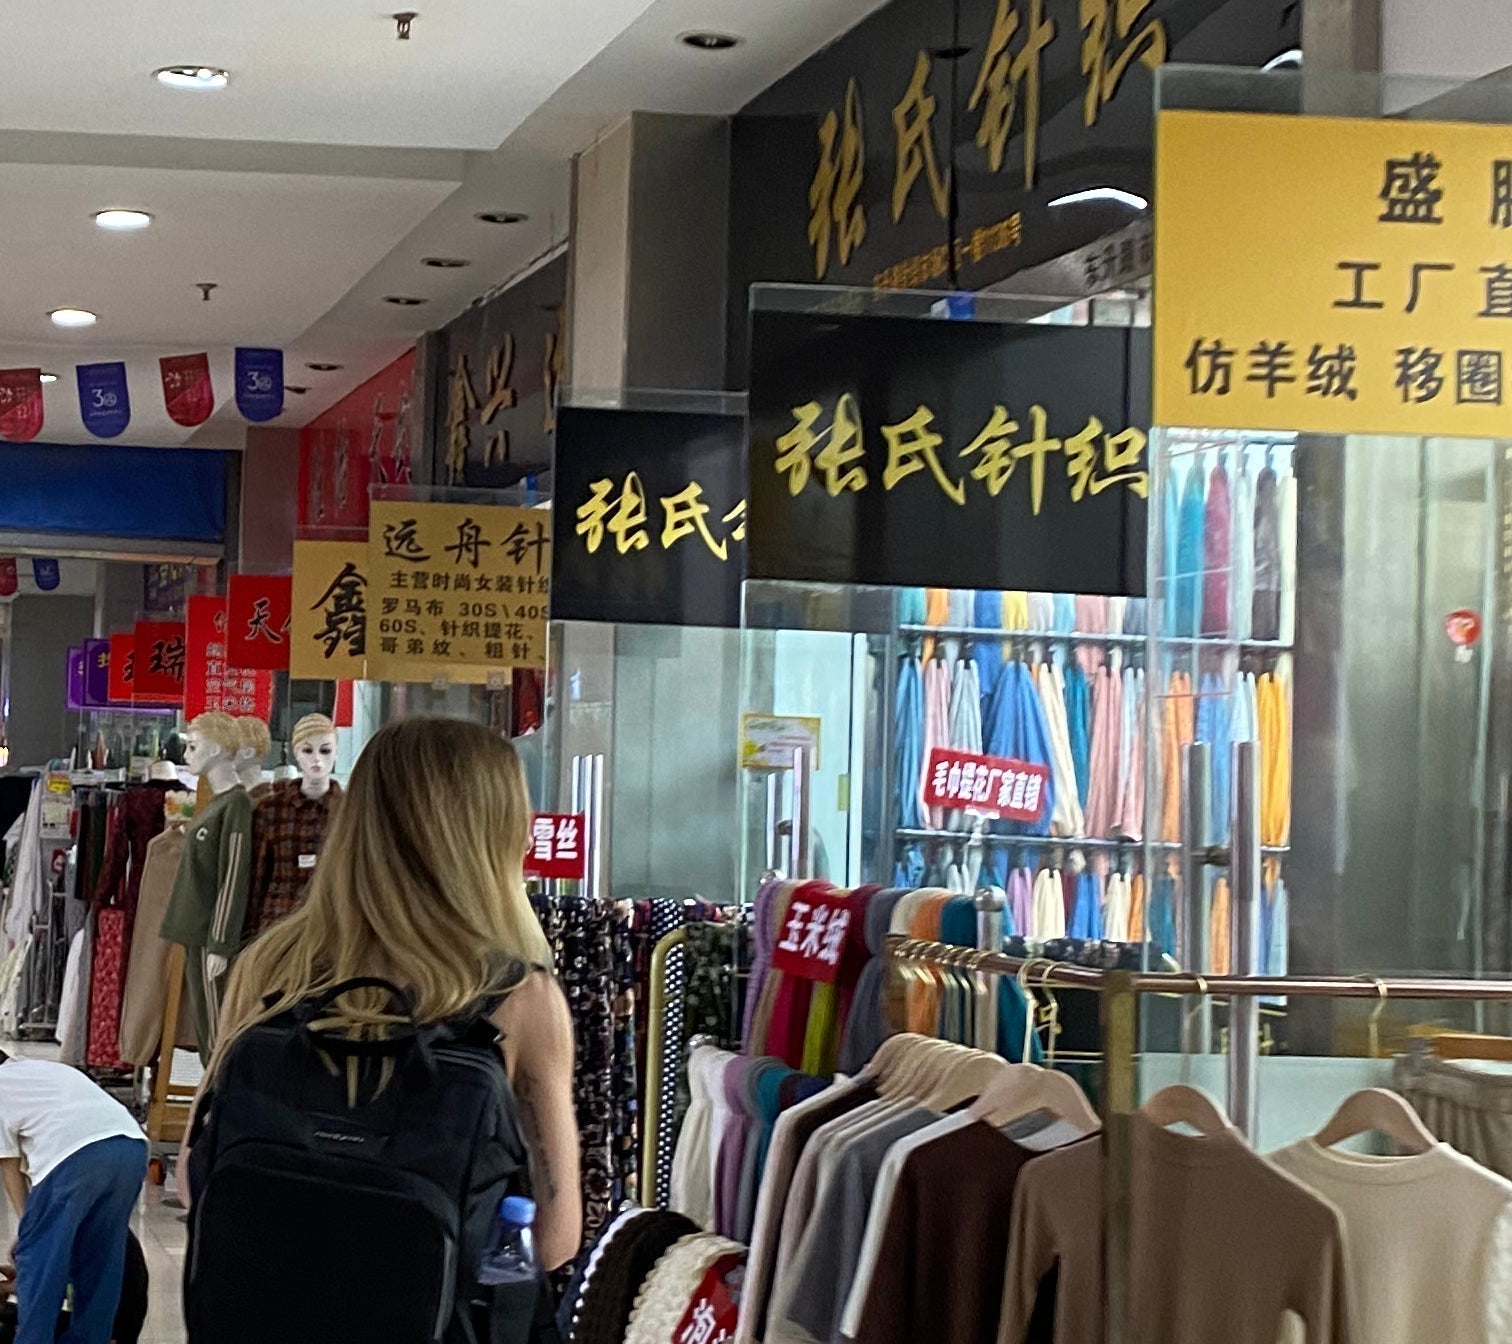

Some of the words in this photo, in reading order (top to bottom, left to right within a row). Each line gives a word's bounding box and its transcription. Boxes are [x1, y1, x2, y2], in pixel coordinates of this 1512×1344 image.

[1184, 337, 1359, 403] 仿羊绒
[1395, 346, 1504, 406] 移圈
[775, 392, 1150, 515] 张氏针织
[383, 518, 551, 574] 远舟针
[244, 597, 291, 643] 天
[381, 598, 443, 616] 罗马布
[529, 818, 579, 861] 雪丝
